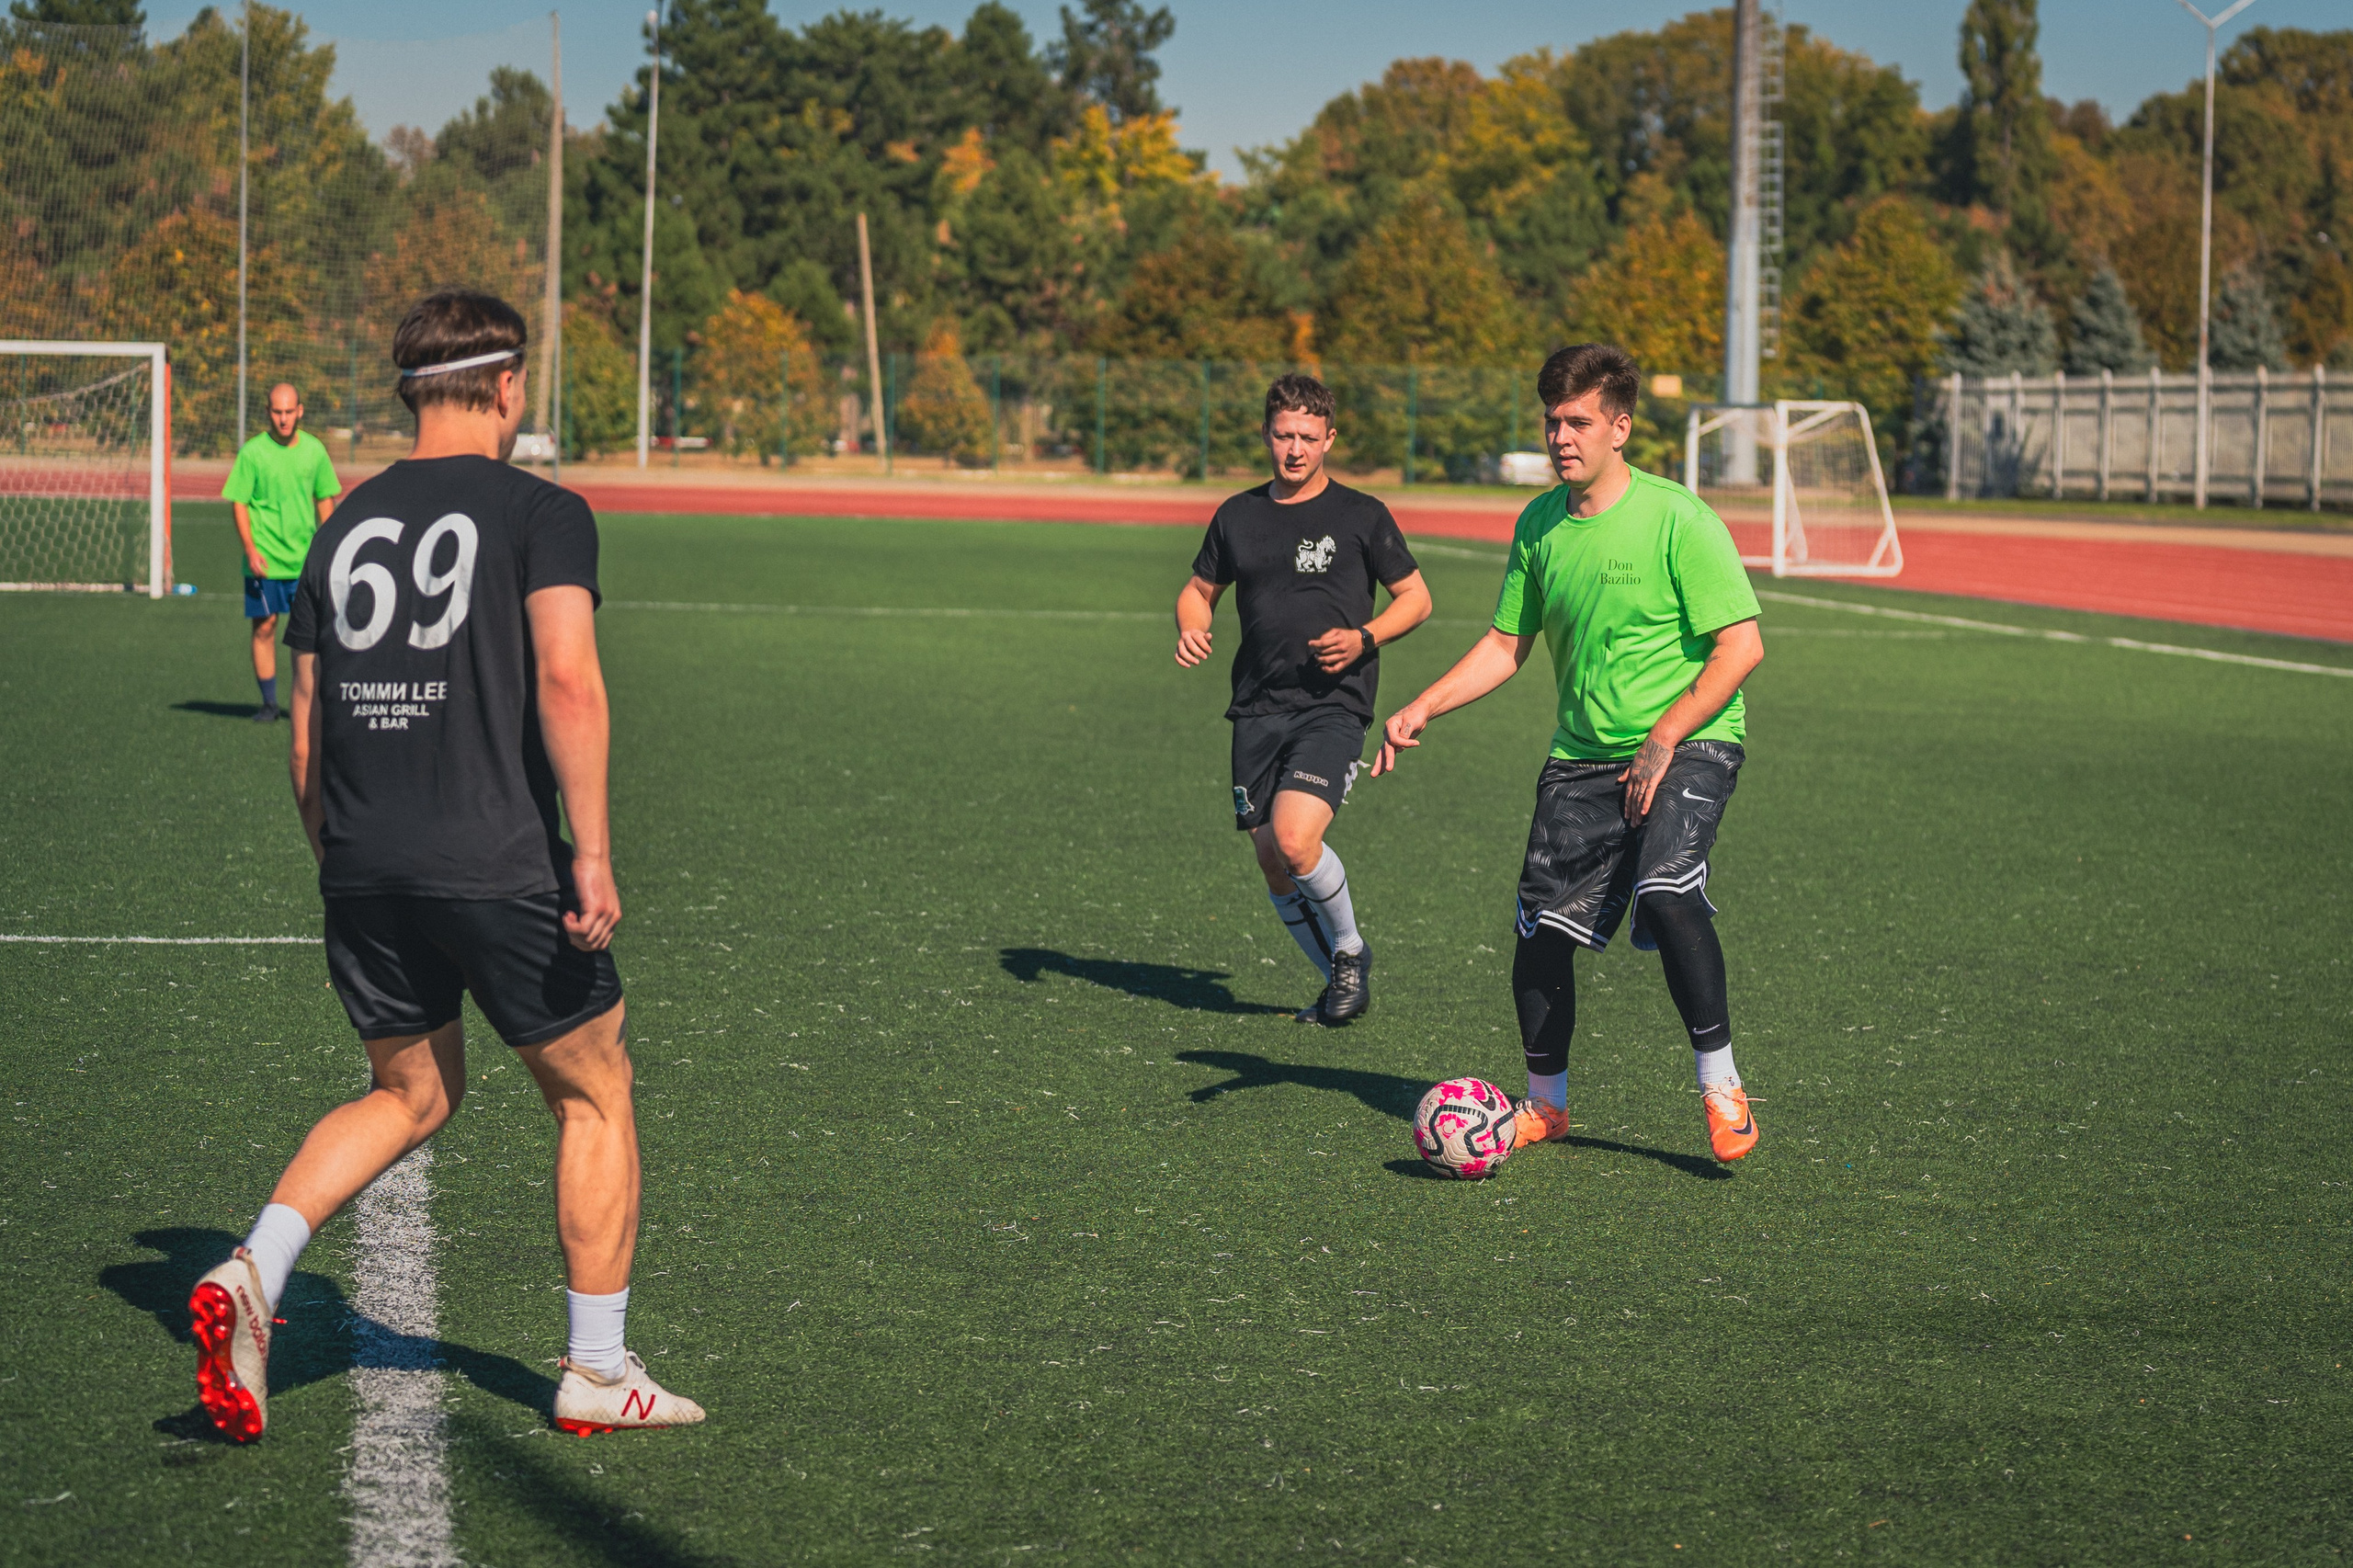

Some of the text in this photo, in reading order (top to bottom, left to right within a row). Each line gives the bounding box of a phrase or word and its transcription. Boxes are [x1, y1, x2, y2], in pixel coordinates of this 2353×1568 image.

[1608, 559, 1632, 571] Don
[329, 512, 478, 651] 69
[1600, 573, 1641, 585] Bazilio
[412, 681, 448, 701] LEE
[352, 703, 429, 717] ASIAN GRILL
[368, 717, 409, 730] & BAR
